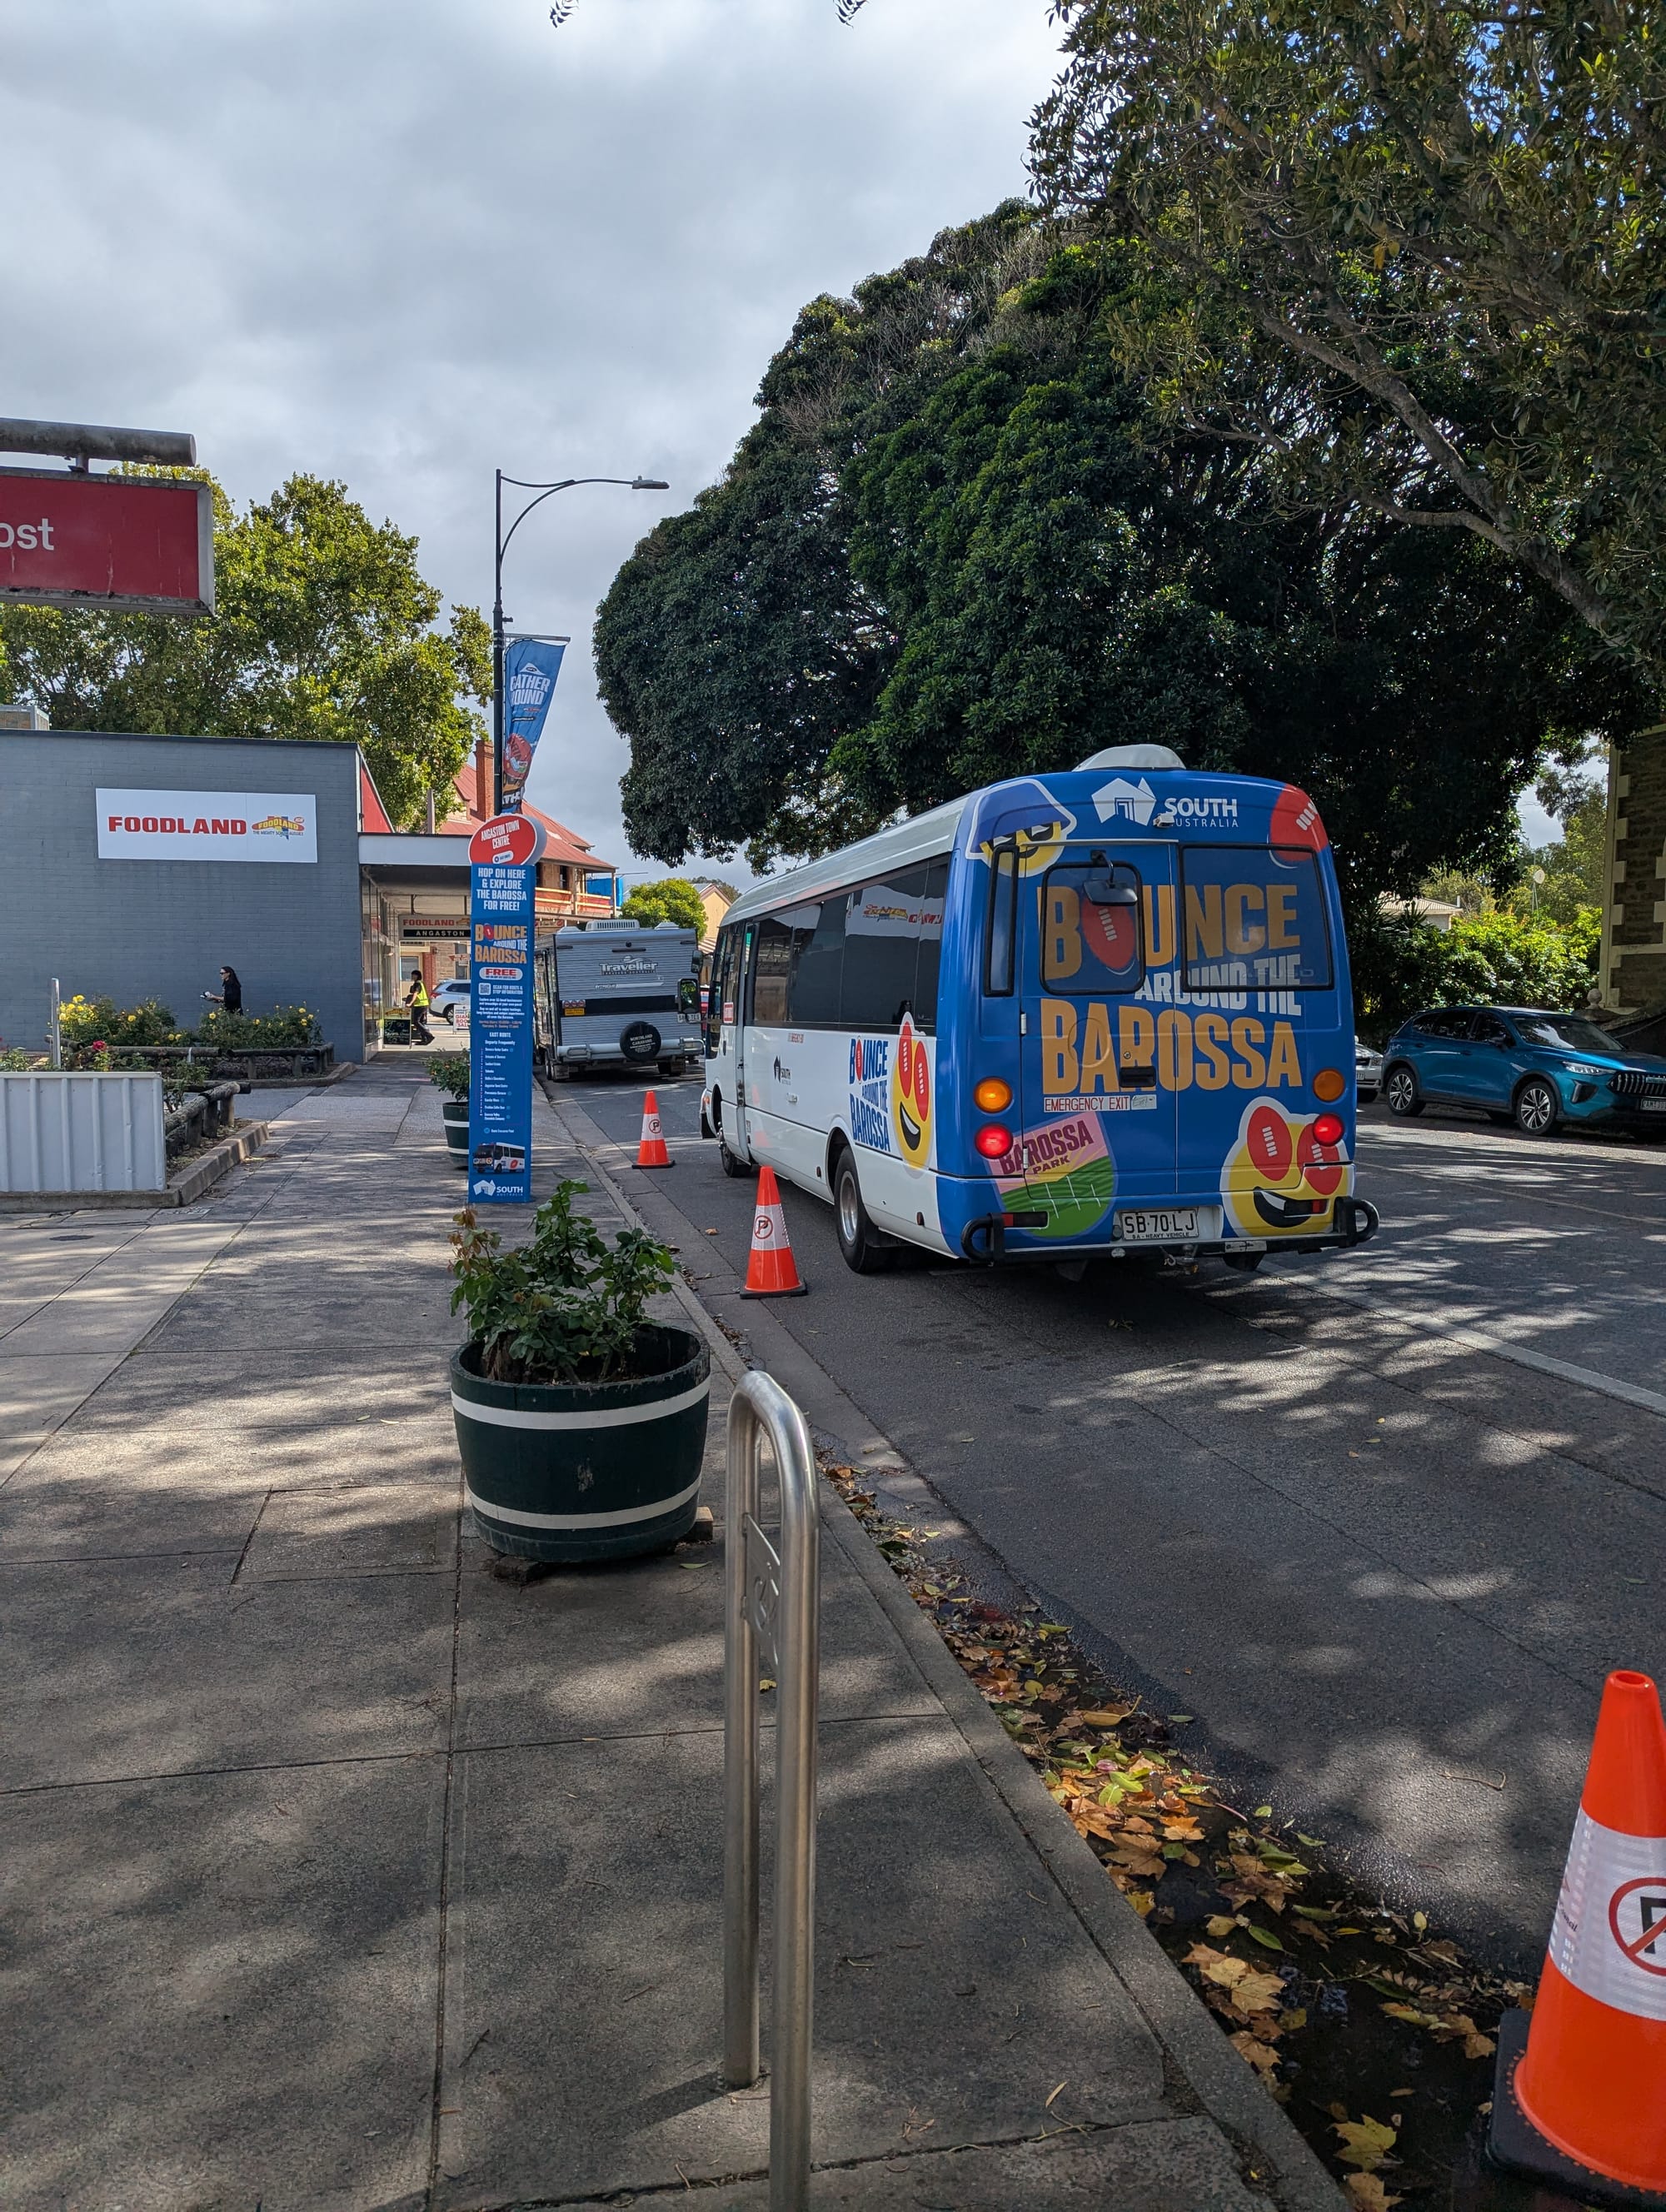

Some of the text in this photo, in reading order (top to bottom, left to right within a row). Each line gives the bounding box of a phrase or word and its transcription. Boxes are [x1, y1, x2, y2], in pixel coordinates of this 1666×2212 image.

[510, 674, 551, 692] GATHER
[1165, 797, 1237, 817] SOUTH
[108, 816, 247, 835] FOODLAND
[258, 818, 298, 830] FOODLAND
[481, 819, 520, 842] ANGASTON TOWN
[1170, 818, 1239, 828] USTRALIA
[491, 834, 511, 849] CENTRE
[478, 867, 526, 879] HOP ON HERE
[481, 879, 522, 889] & EXPLORE
[476, 889, 526, 900] THE BAROSSA
[483, 900, 520, 911] FOR FREE!
[493, 939, 527, 950] AROUND THE
[475, 944, 527, 964] BAROSSA
[600, 961, 658, 972] Traveller
[1135, 954, 1301, 1016] AROUND THE
[1041, 999, 1303, 1094] BAROSSA
[862, 1079, 889, 1114] AROUND THE
[1045, 1097, 1105, 1112] EMERGENCY
[1109, 1096, 1129, 1110] EXIT
[850, 1093, 890, 1153] BAROSSA
[1000, 1120, 1095, 1174] BAROSSA
[1033, 1155, 1070, 1174] PARK
